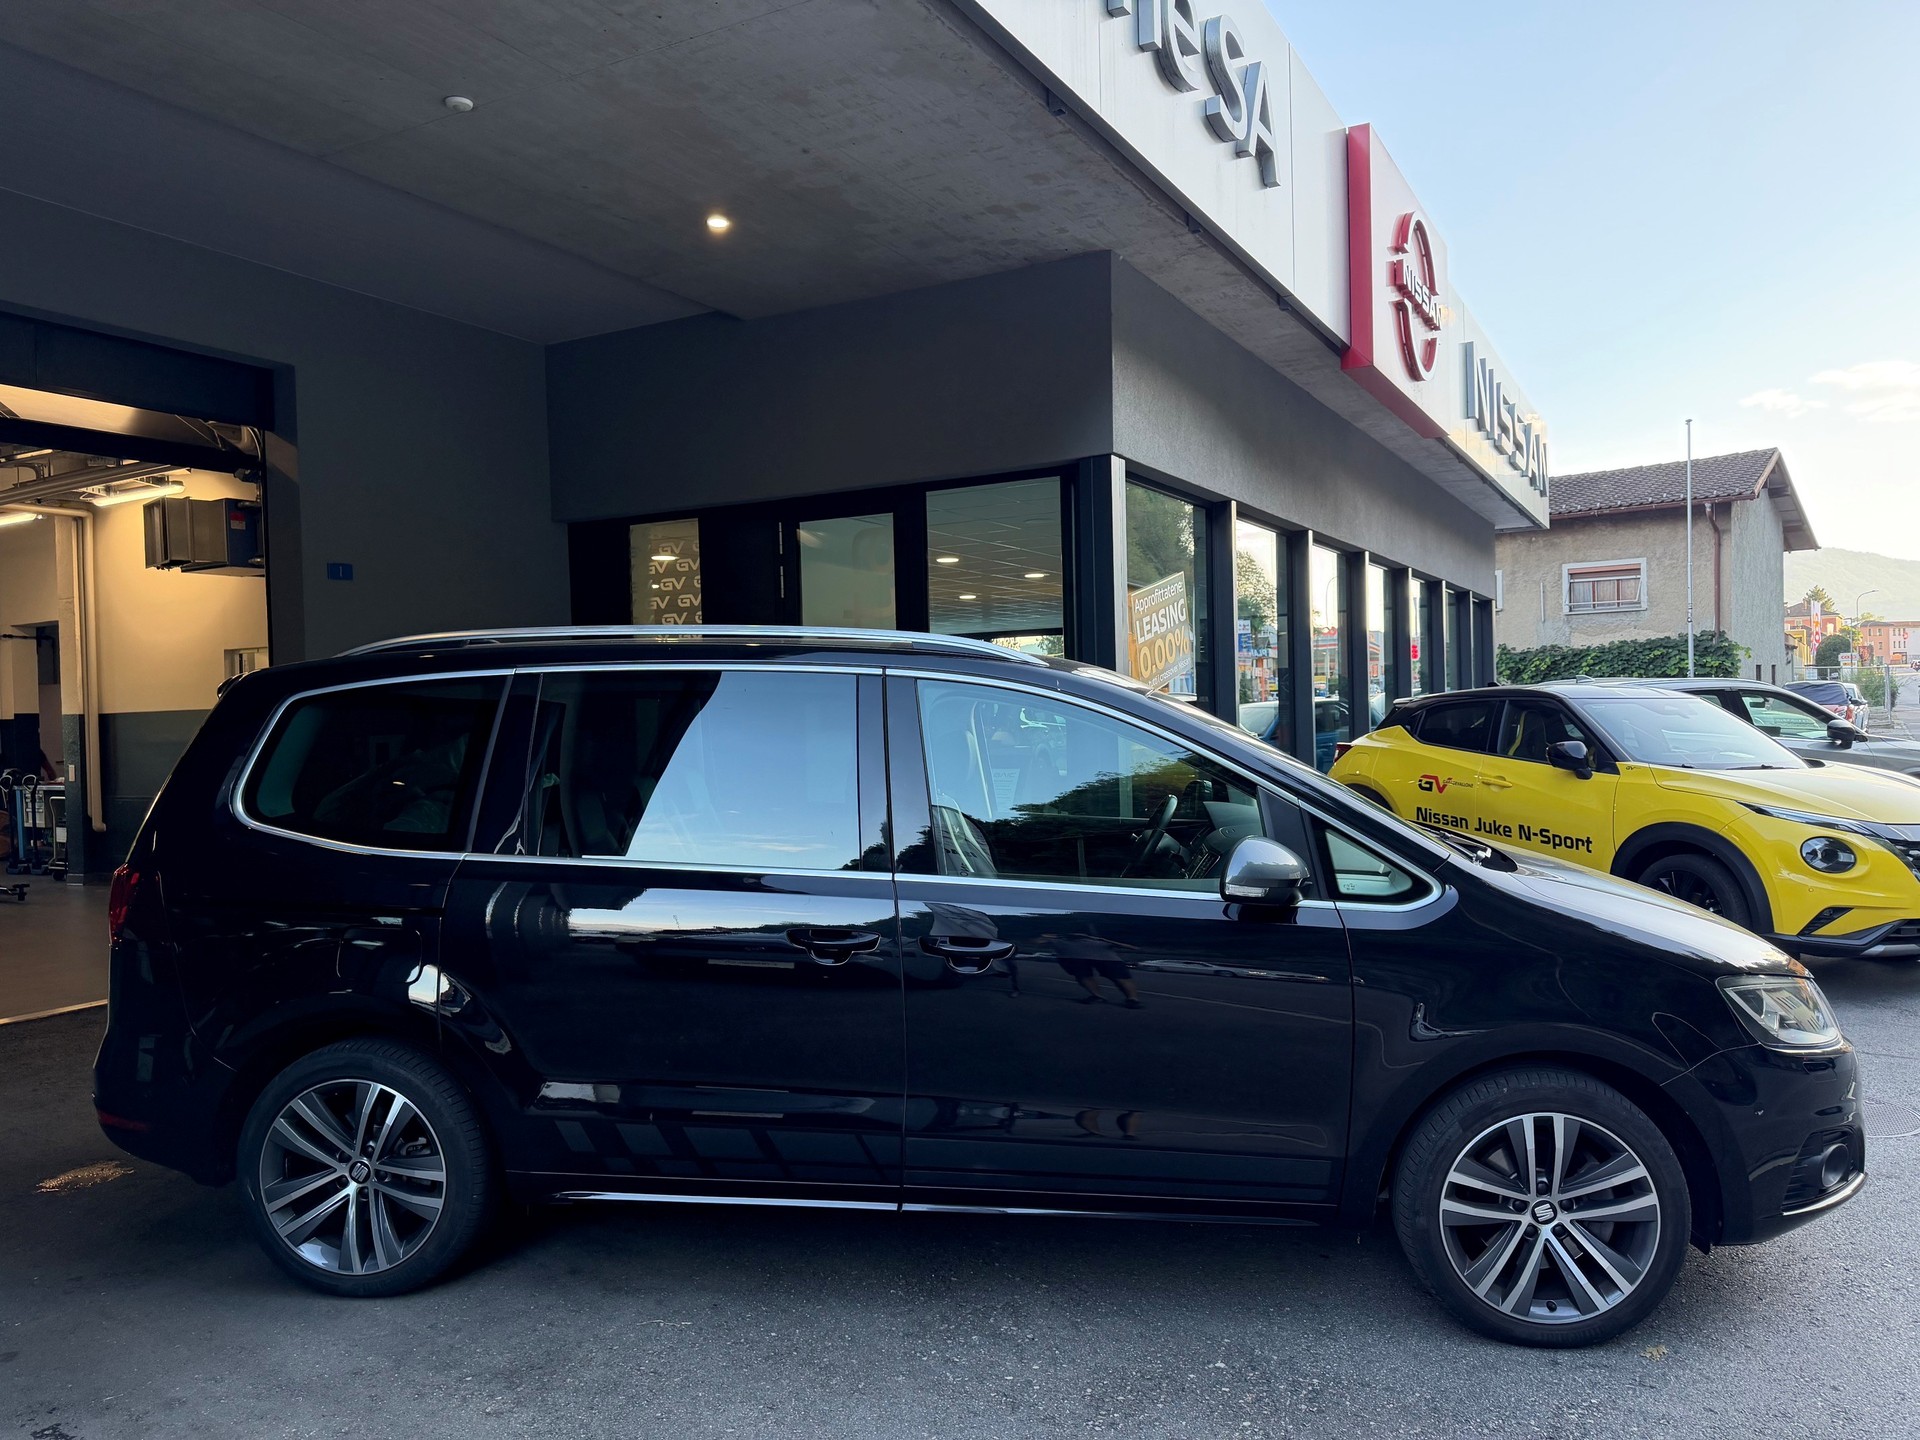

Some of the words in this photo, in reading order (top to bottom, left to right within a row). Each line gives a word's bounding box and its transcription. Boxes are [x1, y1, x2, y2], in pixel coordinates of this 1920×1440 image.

[1404, 265, 1442, 328] NISSAN
[1466, 341, 1548, 497] NISSAN
[661, 577, 686, 590] GV
[1136, 598, 1186, 645] LEASING
[1140, 625, 1190, 679] 0.00%
[1418, 774, 1448, 794] GV
[1416, 806, 1469, 830] Nissan
[1474, 817, 1512, 838] Juke
[1518, 824, 1593, 853] N-Sport
